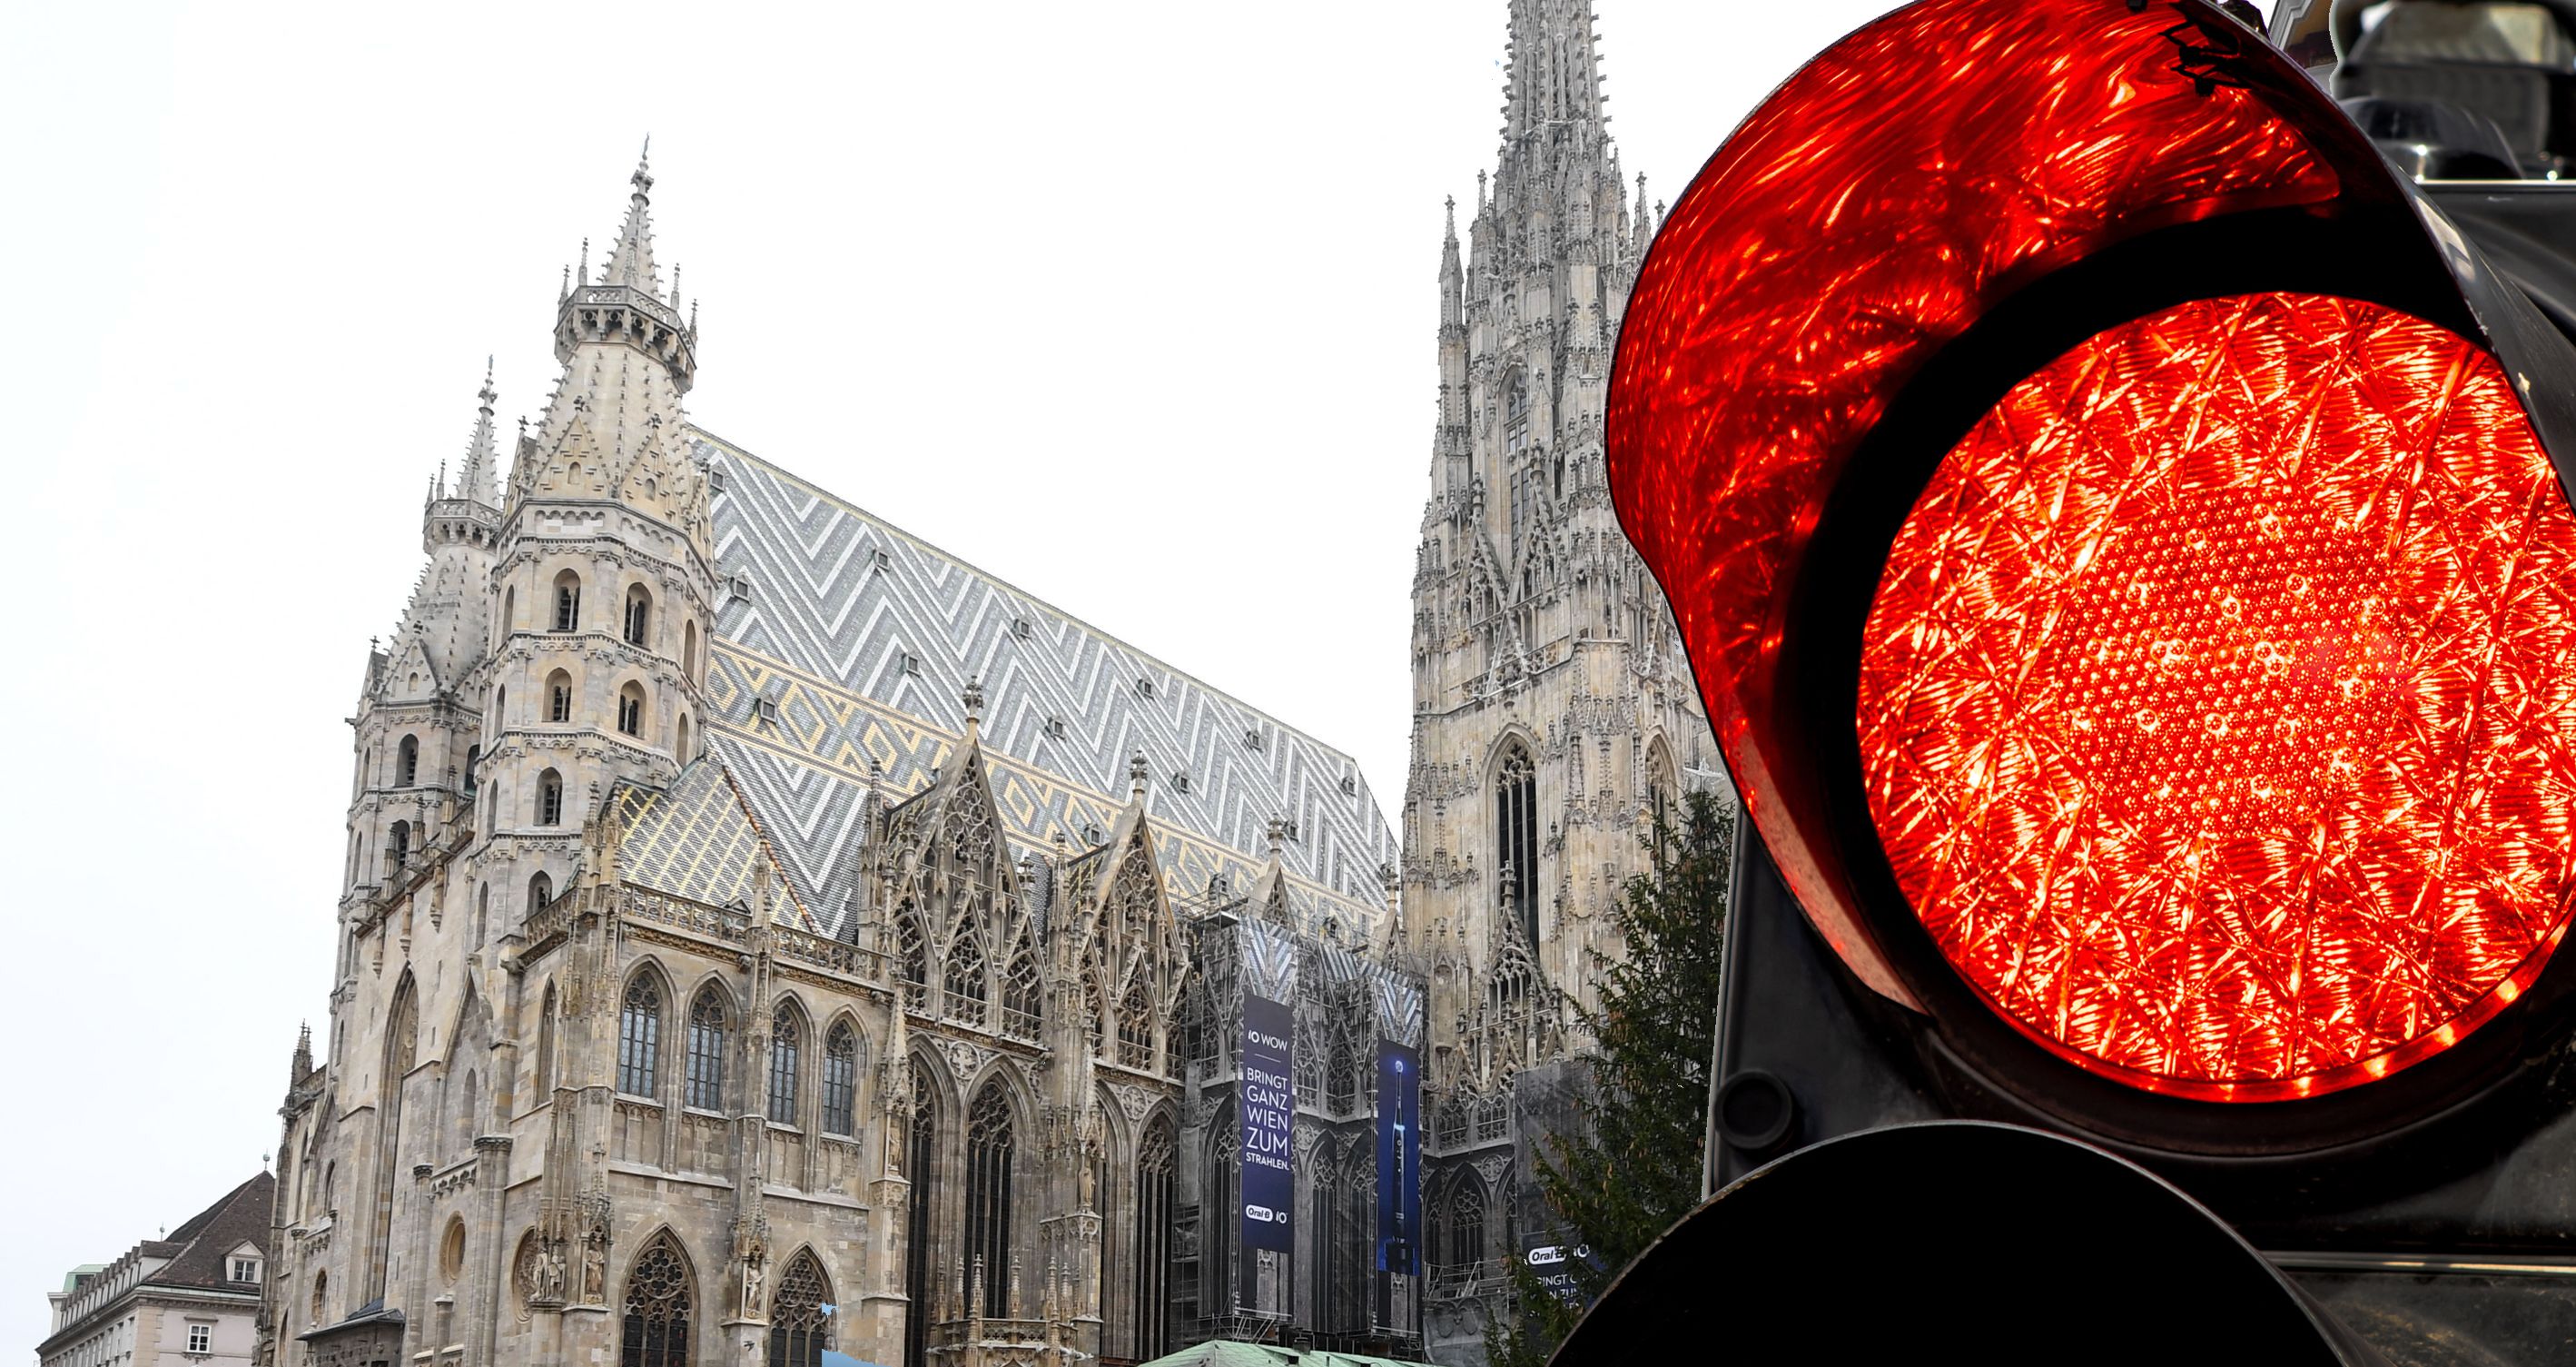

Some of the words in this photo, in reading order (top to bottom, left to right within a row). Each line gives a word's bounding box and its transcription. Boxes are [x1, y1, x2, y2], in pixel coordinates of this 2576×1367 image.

[1261, 1033, 1288, 1052] WOW
[1247, 1066, 1288, 1090] BRINGT
[1247, 1085, 1288, 1111] GANZ
[1247, 1104, 1288, 1132] WIEN
[1247, 1126, 1288, 1156] ZUM
[1246, 1152, 1289, 1171] STRAHLEN.
